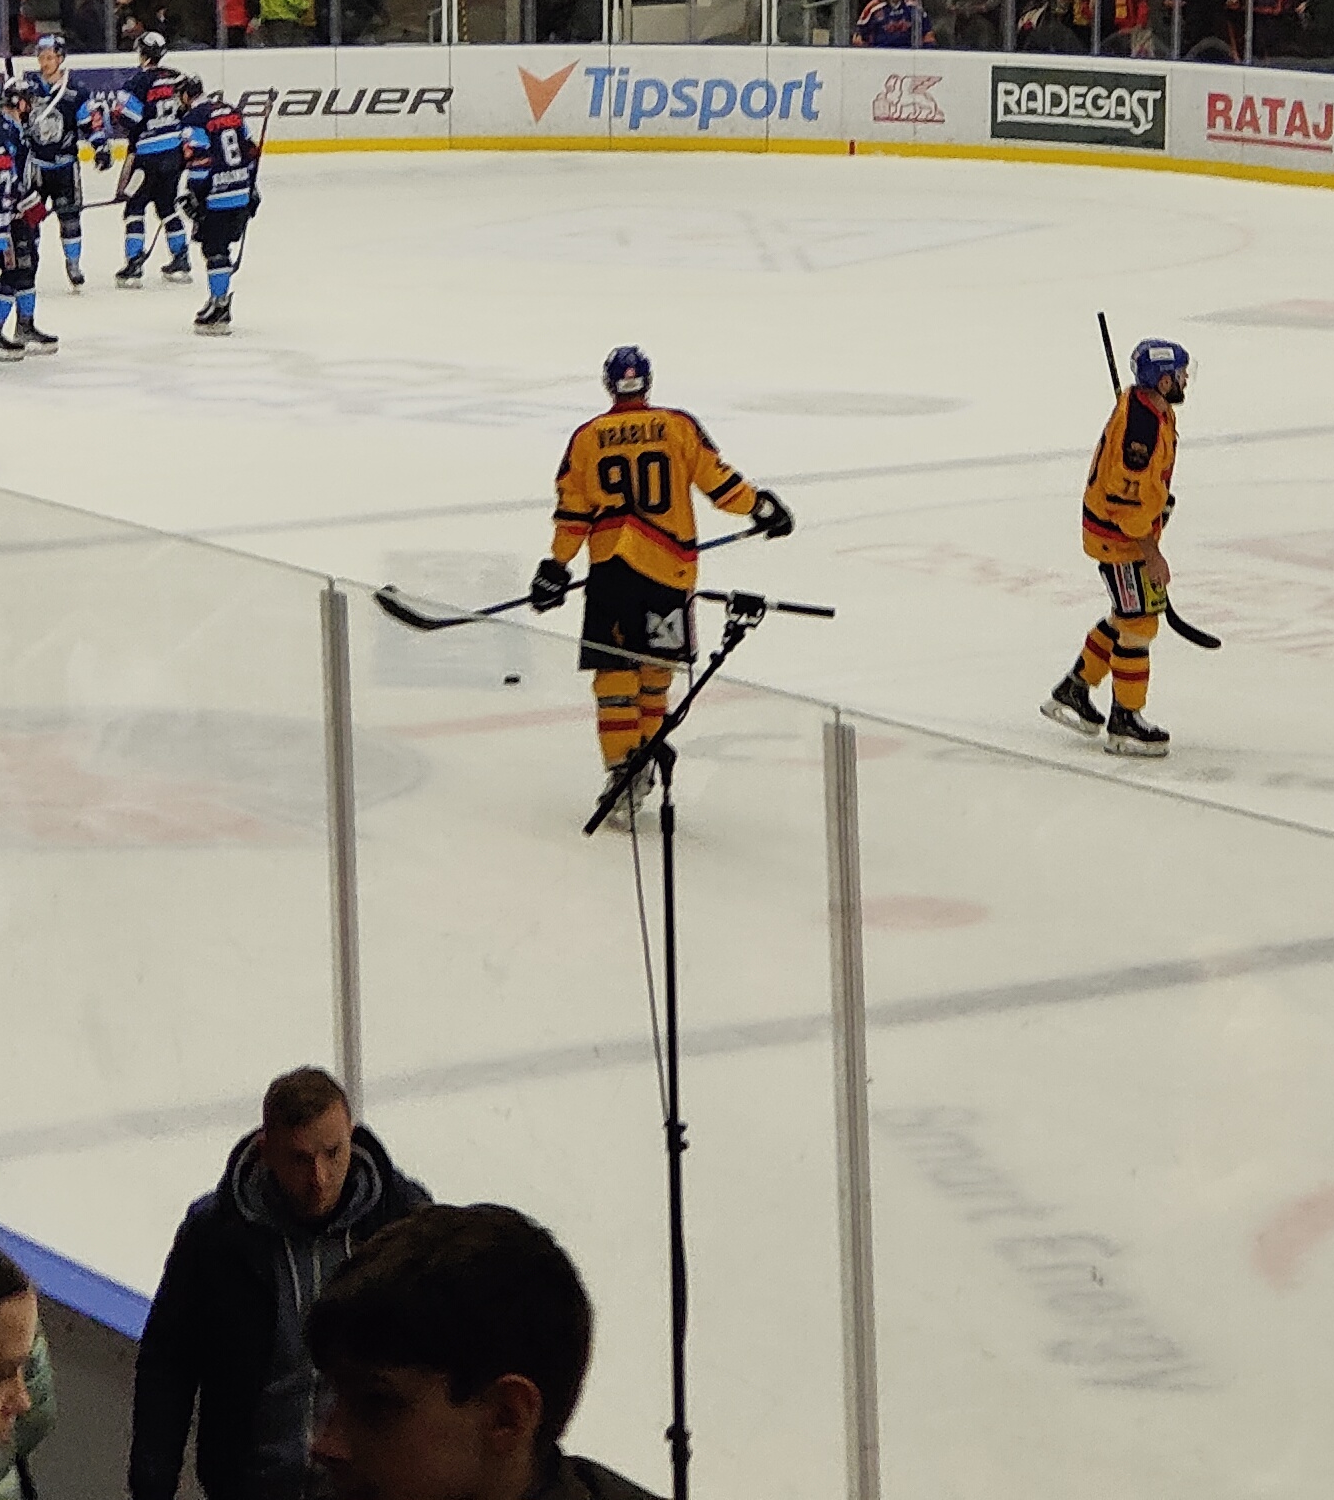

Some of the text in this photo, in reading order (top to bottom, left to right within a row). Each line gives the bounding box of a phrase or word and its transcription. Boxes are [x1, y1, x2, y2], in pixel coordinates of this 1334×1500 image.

[583, 65, 824, 130] Tipsport
[995, 80, 1162, 135] RADEGAST
[1206, 92, 1334, 141] RATAJ
[221, 128, 240, 167] 8
[597, 450, 672, 515] 90
